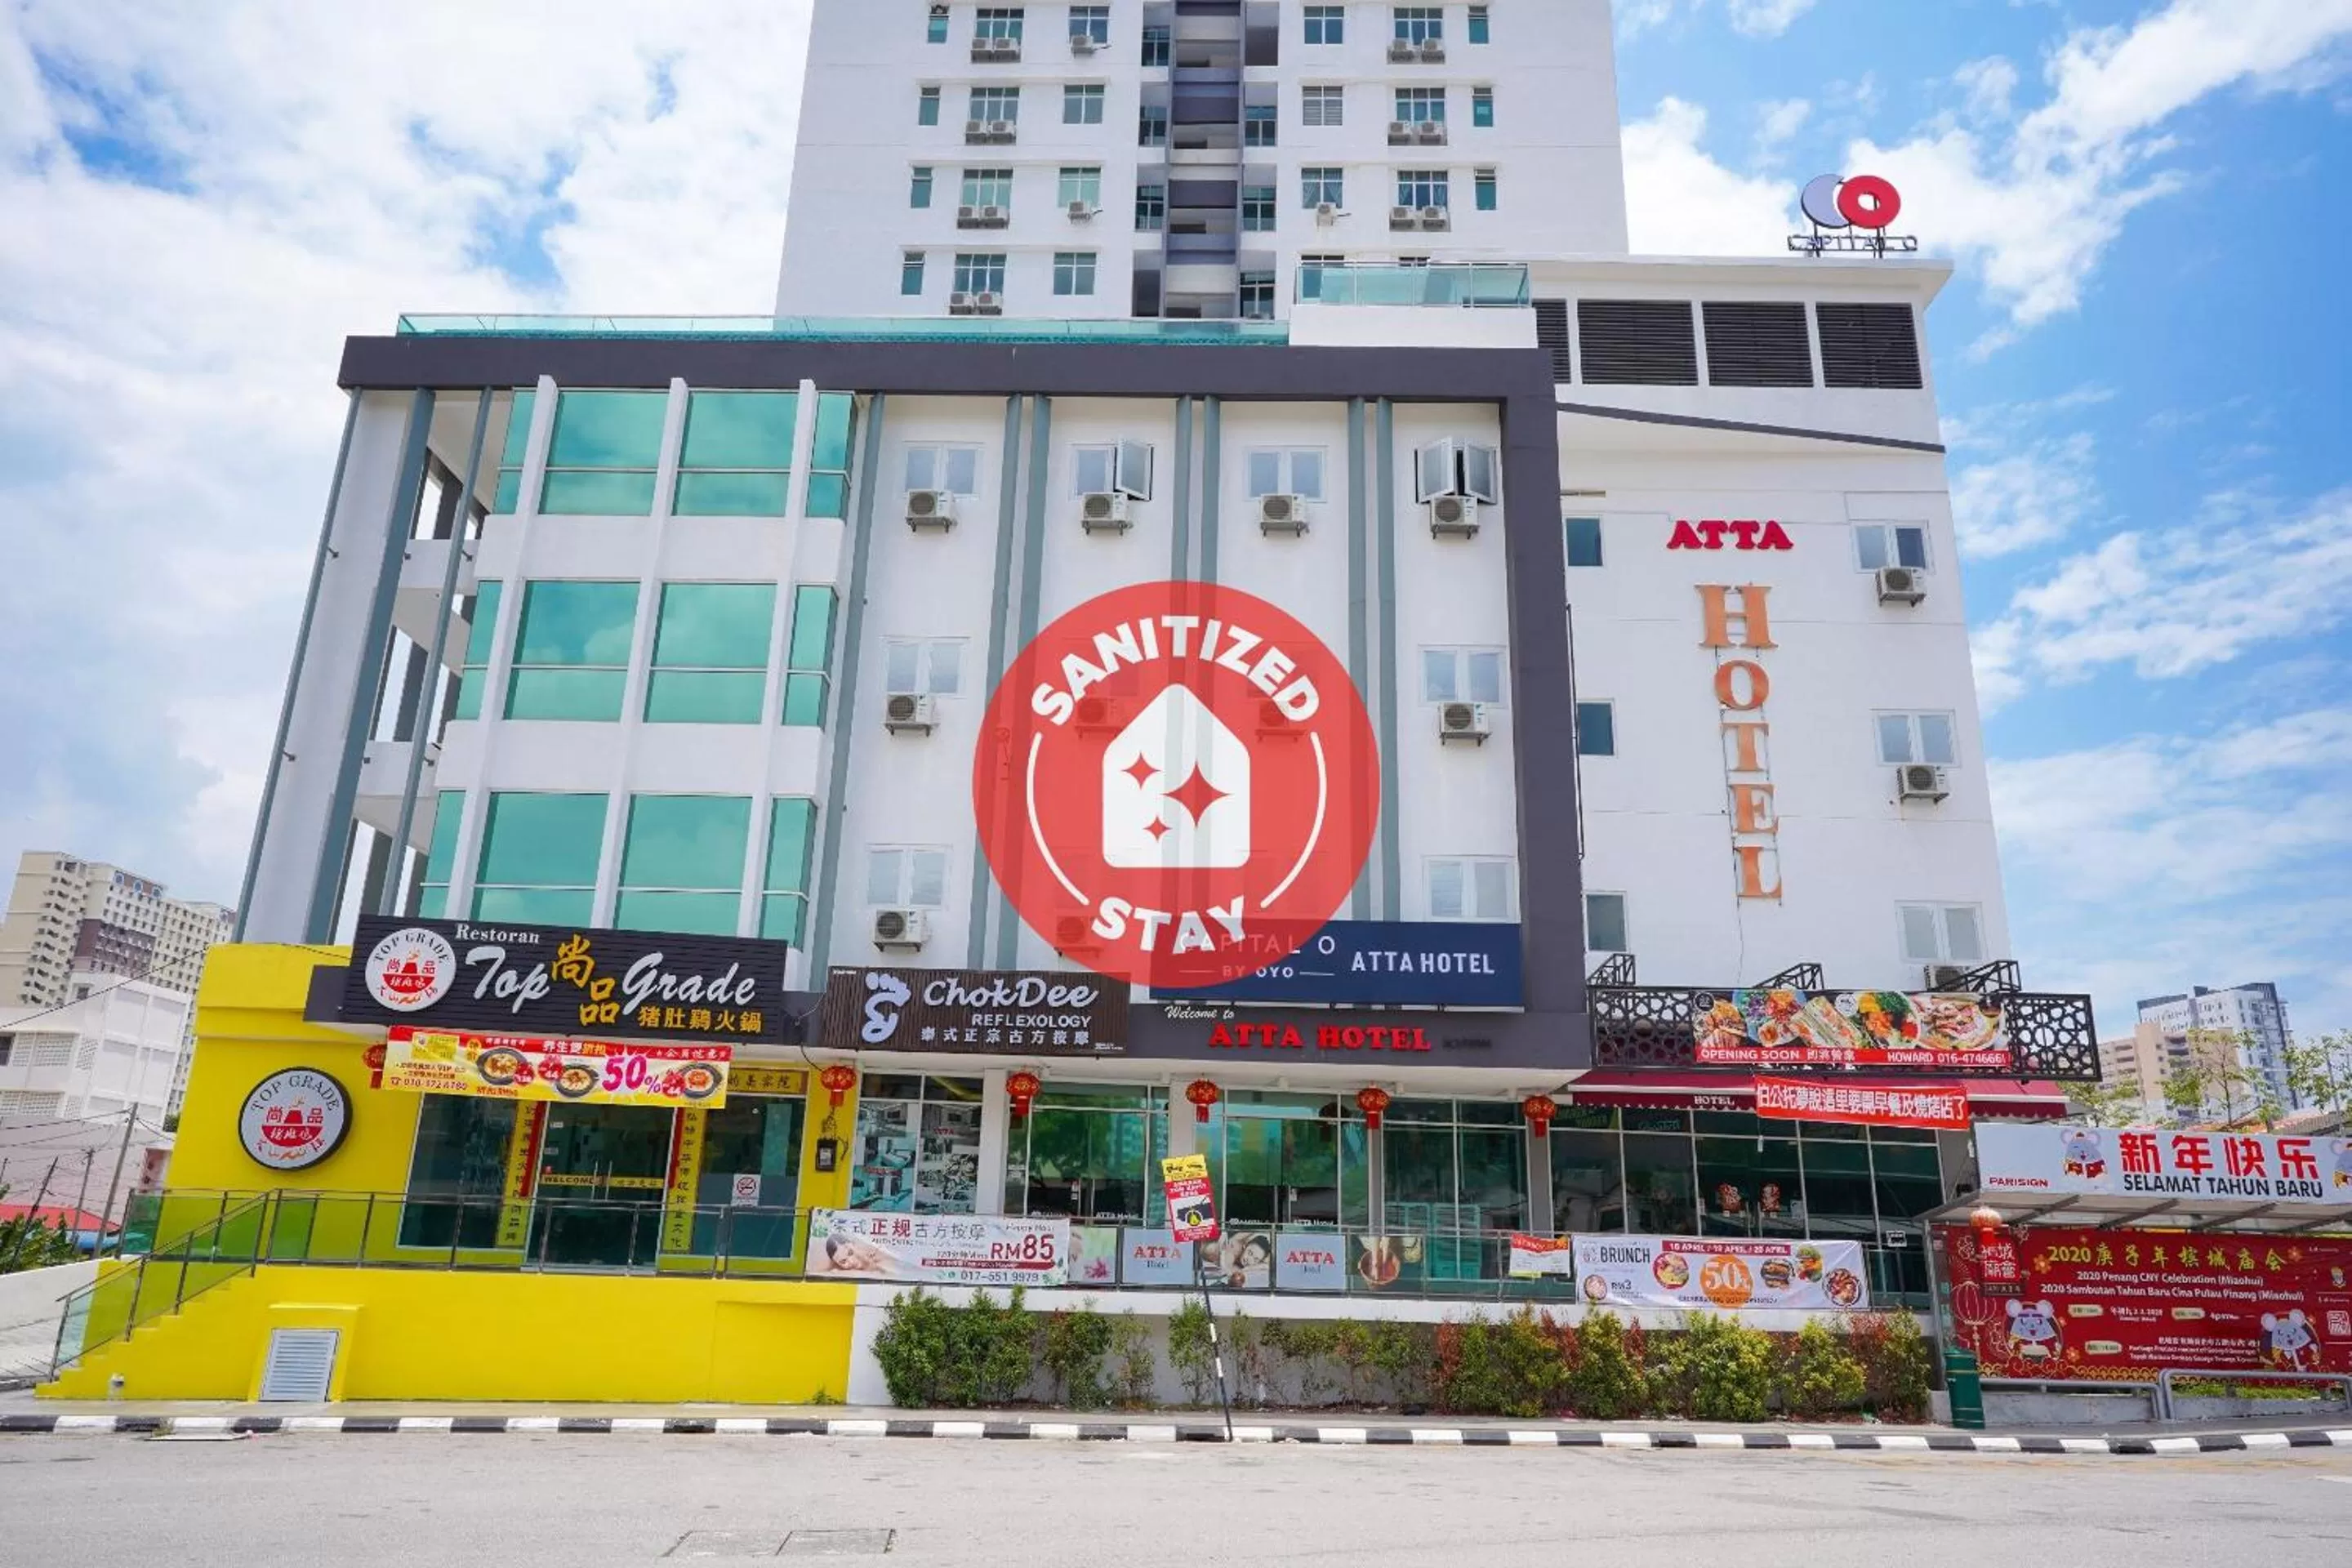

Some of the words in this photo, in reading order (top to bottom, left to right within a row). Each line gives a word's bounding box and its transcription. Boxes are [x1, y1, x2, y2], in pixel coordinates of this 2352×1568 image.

[1666, 520, 1794, 550] ATTA
[1693, 582, 1783, 900] HOTEL
[454, 922, 541, 945] Restoran
[373, 935, 399, 962] TOP
[405, 932, 450, 964] GRADE
[1317, 935, 1335, 955] O
[1222, 964, 1246, 978] BY
[1255, 966, 1294, 978] OYO
[1351, 951, 1414, 973] ATTA
[1419, 952, 1495, 974] HOTEL
[465, 945, 550, 1014] Top
[550, 933, 621, 1027] 尚品
[621, 951, 756, 1016] Grade
[923, 976, 1100, 1009] ChokDee
[971, 1013, 1092, 1028] REFLEXOLOGY
[1163, 1005, 1218, 1020] Welcome
[1223, 1009, 1235, 1019] to
[1207, 1022, 1304, 1049] ATTA
[1316, 1024, 1432, 1052] HOTEL
[1700, 1048, 1758, 1060] OPENING
[1762, 1049, 1800, 1060] SOON
[1887, 1052, 1934, 1062] HOWARD
[251, 1080, 283, 1111] TOP
[288, 1075, 341, 1111] GRADE
[1694, 1095, 1735, 1106] HOTEL
[2118, 1132, 2321, 1180] 新年快乐
[1989, 1176, 2049, 1188] PARISIGN
[2123, 1174, 2202, 1193] SELAMAT
[2206, 1177, 2270, 1196] TAHUN
[2276, 1179, 2324, 1199] BARU
[990, 1233, 1055, 1261] RM85
[1133, 1245, 1182, 1258] ATTA
[1286, 1250, 1336, 1265] ATTA
[1600, 1245, 1650, 1263] BRUNCH
[2047, 1245, 2091, 1263] 2020
[2077, 1271, 2101, 1281] 2020
[2102, 1272, 2139, 1284] Penang
[2140, 1272, 2158, 1282] CNY
[2161, 1272, 2216, 1285] Celebration
[2041, 1283, 2065, 1294] 2020
[2066, 1284, 2116, 1295] Sambutan
[2117, 1285, 2146, 1296] Tahun
[2147, 1287, 2172, 1297] Baru
[2172, 1287, 2193, 1298] Cina
[2194, 1288, 2222, 1298] Pulau
[2223, 1289, 2257, 1302] Pinang
